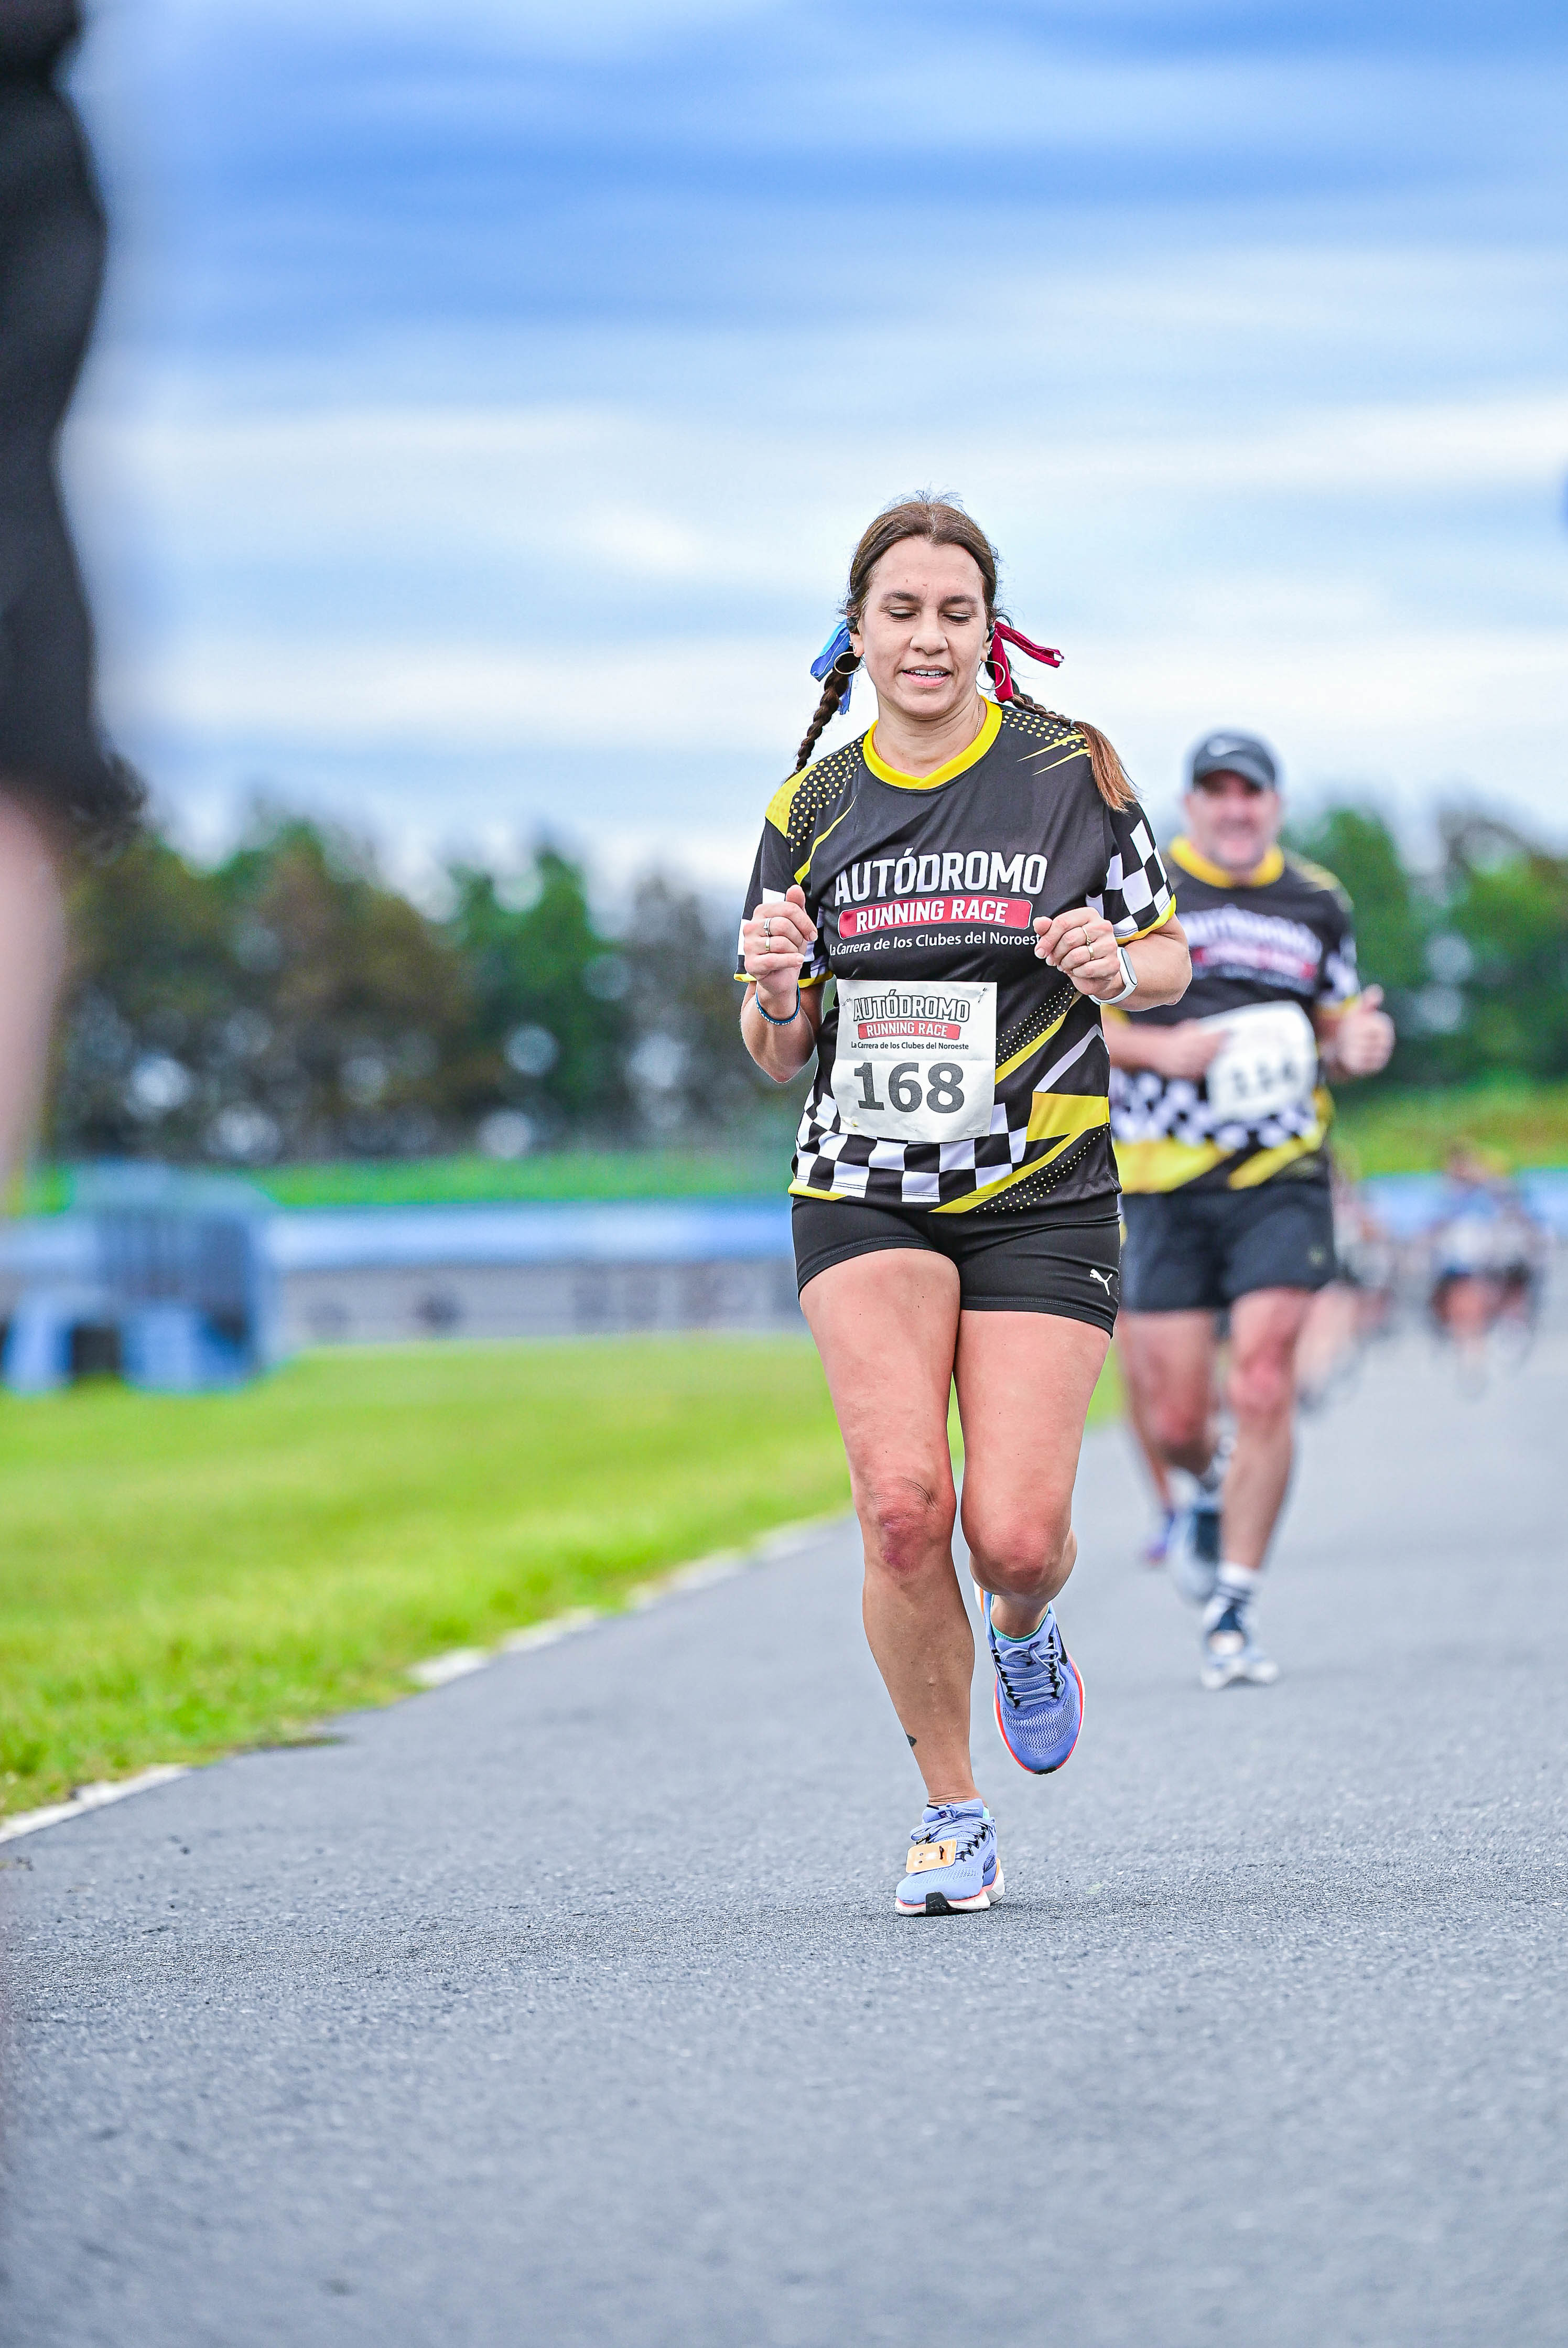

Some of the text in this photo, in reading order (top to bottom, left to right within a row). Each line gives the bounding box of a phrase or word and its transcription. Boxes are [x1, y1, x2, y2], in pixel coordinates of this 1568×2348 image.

[834, 847, 1048, 907] AUTÓDROMO
[856, 899, 1009, 933] RUNNING RACE
[836, 943, 870, 955] Carrera
[873, 938, 890, 950] de
[893, 936, 913, 949] los
[915, 933, 961, 946] Clubes
[965, 931, 986, 944] del
[990, 932, 1041, 945] Noroest
[853, 989, 970, 1022] AUTÓDROMO
[866, 1021, 948, 1037] RUNNING RACE
[854, 1062, 965, 1114] 168
